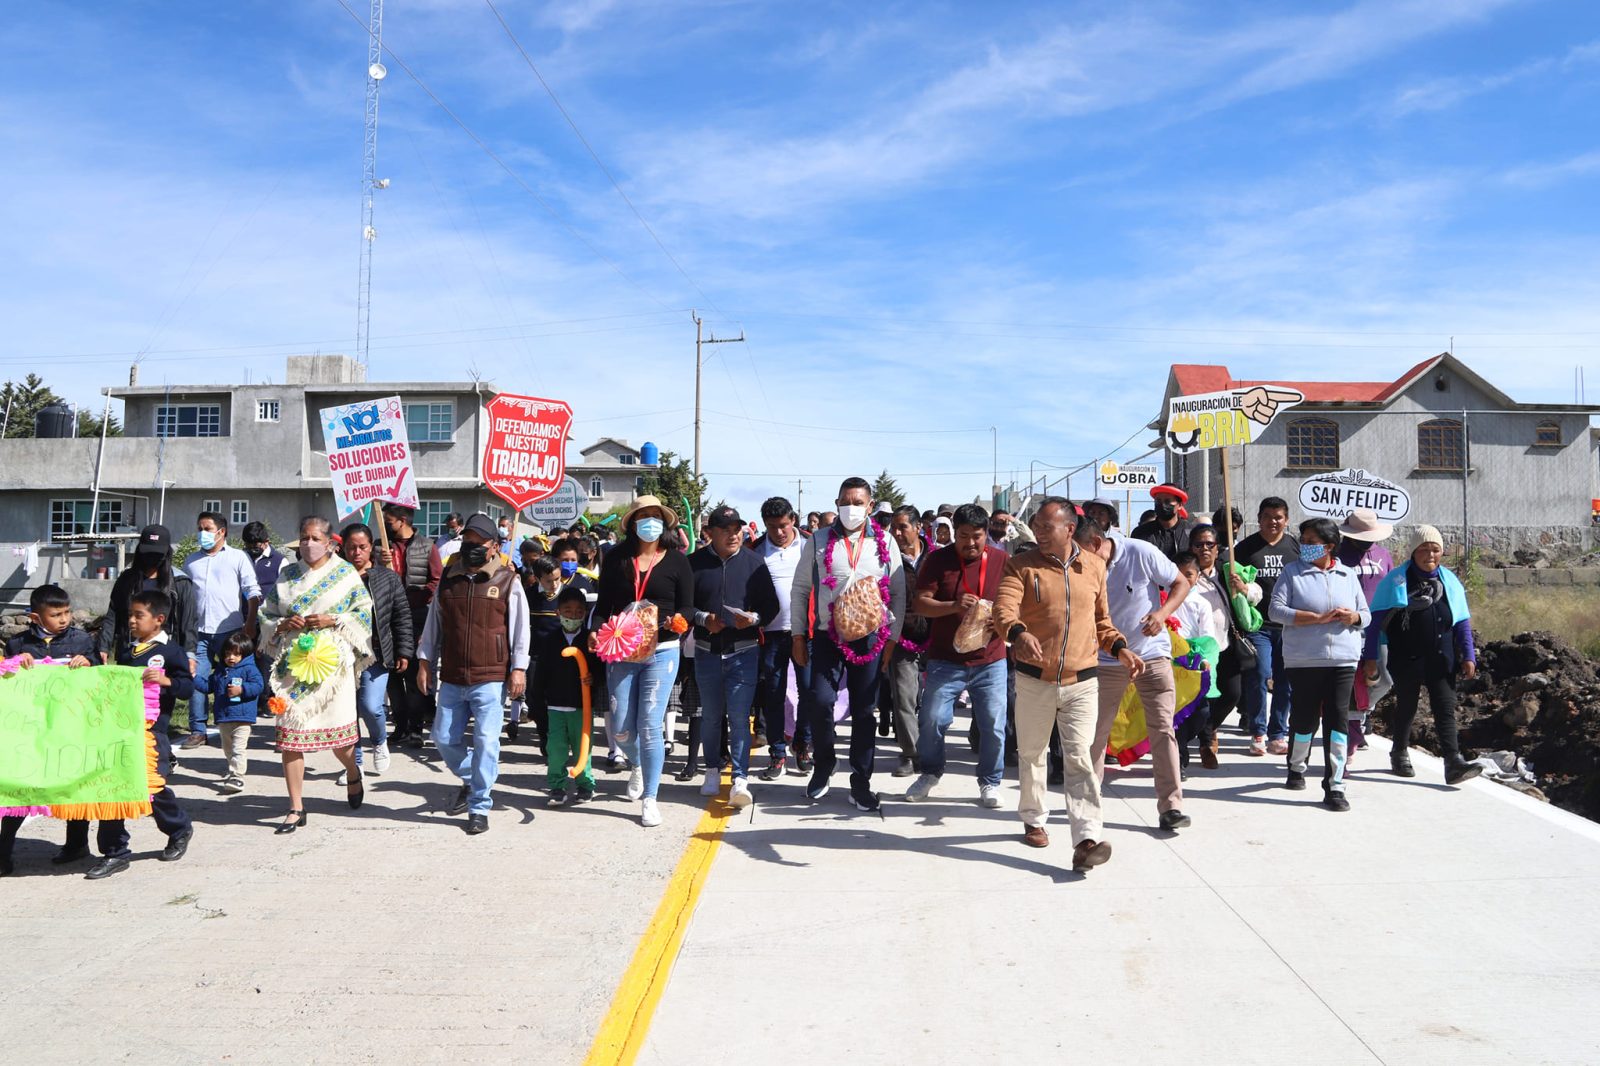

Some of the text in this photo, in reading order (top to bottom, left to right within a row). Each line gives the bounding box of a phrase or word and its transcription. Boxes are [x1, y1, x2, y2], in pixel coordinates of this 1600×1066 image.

[1172, 396, 1243, 414] INAUGURACIÓN DE
[342, 404, 380, 435] NO!
[495, 417, 561, 439] DEFENDAMOS
[504, 433, 549, 453] NUESTRO
[328, 442, 406, 471] SOLUCIONES
[491, 448, 559, 481] TRABAJO
[344, 465, 397, 486] QUE DURAN
[1117, 473, 1157, 484] OBRA
[343, 489, 350, 502] Y
[555, 496, 574, 504] HECHOS
[1310, 485, 1398, 512] SAN FELIPE
[534, 507, 545, 515] QUE
[1263, 555, 1284, 568] FOX
